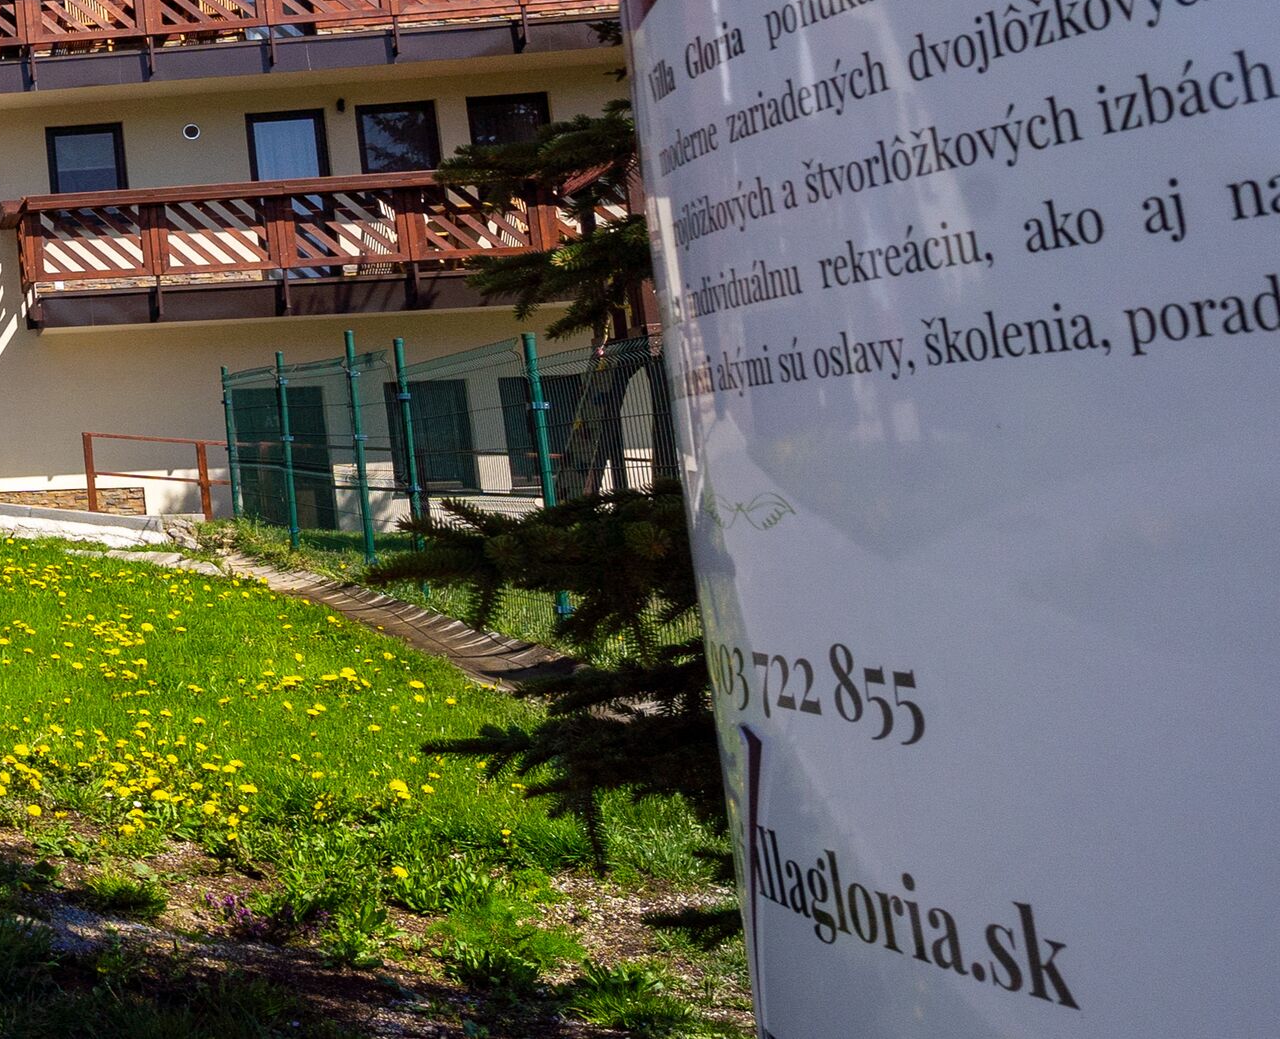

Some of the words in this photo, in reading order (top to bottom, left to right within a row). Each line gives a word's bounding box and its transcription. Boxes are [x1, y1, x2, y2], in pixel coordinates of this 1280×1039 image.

[648, 59, 676, 103] Villa
[685, 21, 746, 79] Gloria
[658, 122, 719, 177] moderne
[726, 50, 891, 144] zariadených
[782, 178, 799, 210] a
[804, 94, 1085, 206] štvorlôžkových
[685, 259, 804, 320] individuálnu
[818, 217, 995, 290] rekreáciu,
[1024, 198, 1106, 255] ako
[1142, 177, 1188, 243] aj
[717, 344, 775, 398] akými
[779, 336, 808, 384] sú
[813, 330, 917, 382] oslavy,
[924, 302, 1112, 368] školenia,
[752, 651, 823, 719] 722
[828, 643, 927, 746] 855
